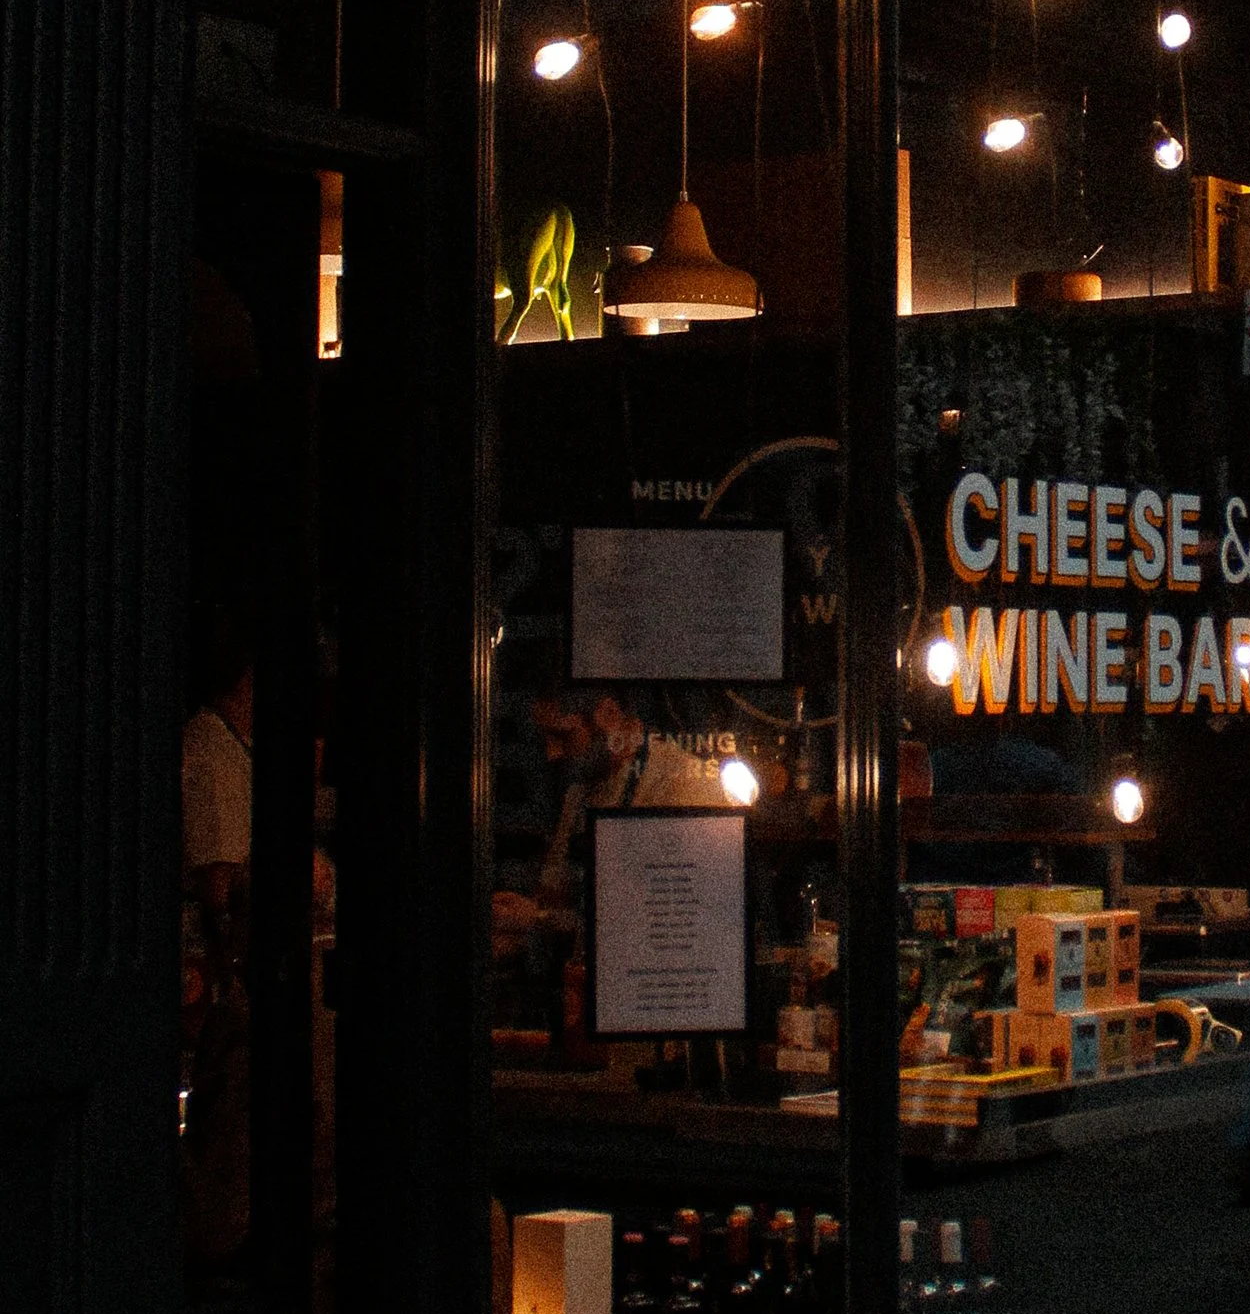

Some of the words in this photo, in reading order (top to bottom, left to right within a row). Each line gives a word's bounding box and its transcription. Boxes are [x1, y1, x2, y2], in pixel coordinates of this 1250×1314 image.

[631, 479, 714, 503] MENU
[945, 472, 1203, 592] CHEESE
[945, 605, 1134, 716] WINE
